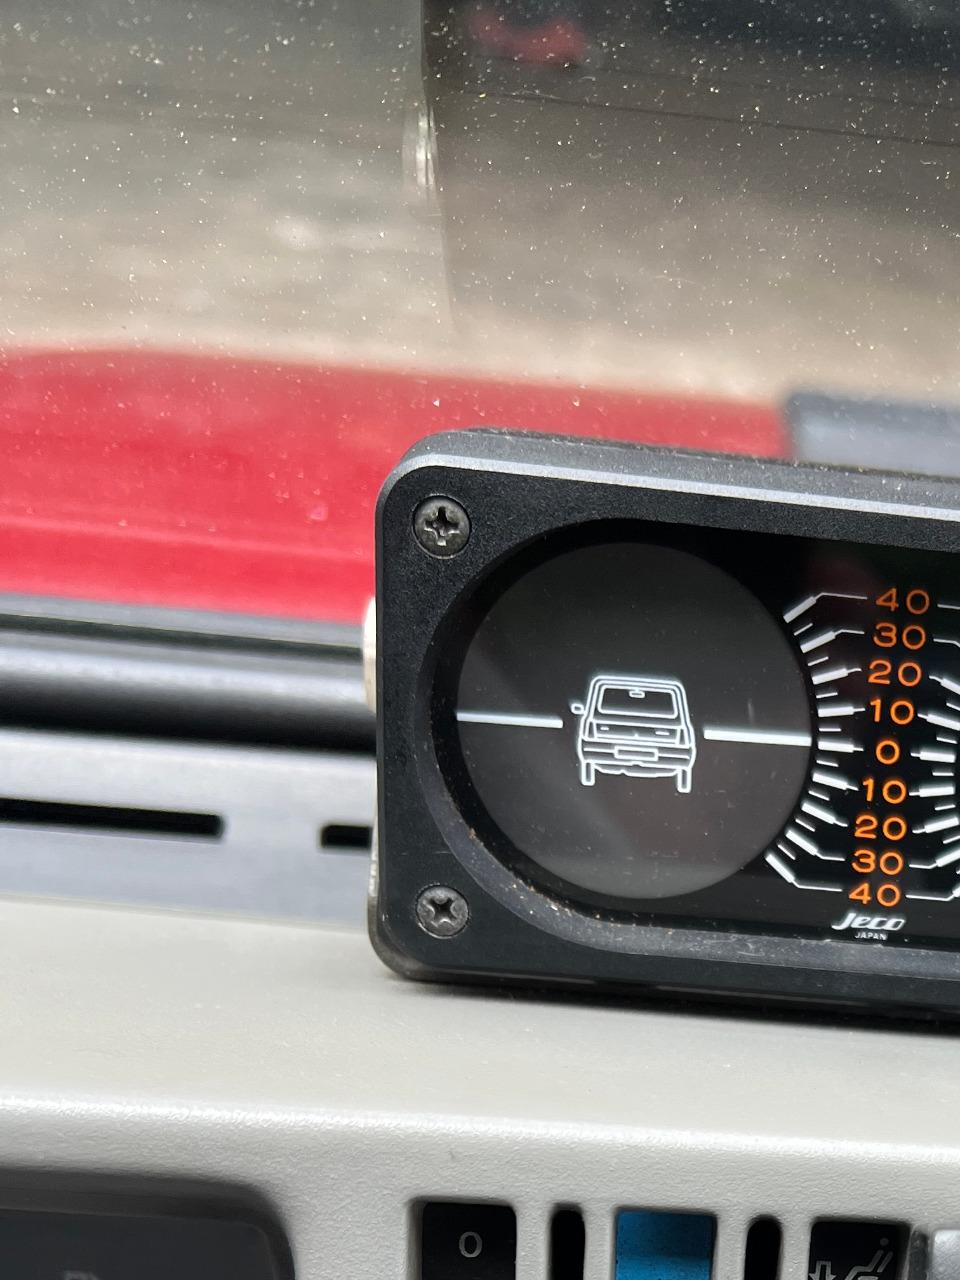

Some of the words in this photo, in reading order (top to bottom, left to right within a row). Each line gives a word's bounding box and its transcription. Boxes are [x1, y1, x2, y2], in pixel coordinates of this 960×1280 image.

[876, 587, 929, 615] 40
[873, 622, 927, 651] 30
[867, 658, 923, 688] 20
[870, 698, 915, 726] 10
[875, 738, 901, 766] 0
[863, 777, 908, 805] 10
[853, 813, 908, 842] 20
[851, 848, 905, 877] 30
[848, 882, 902, 908] 40
[854, 931, 887, 941] JAPAN
[459, 1231, 483, 1258] 0
